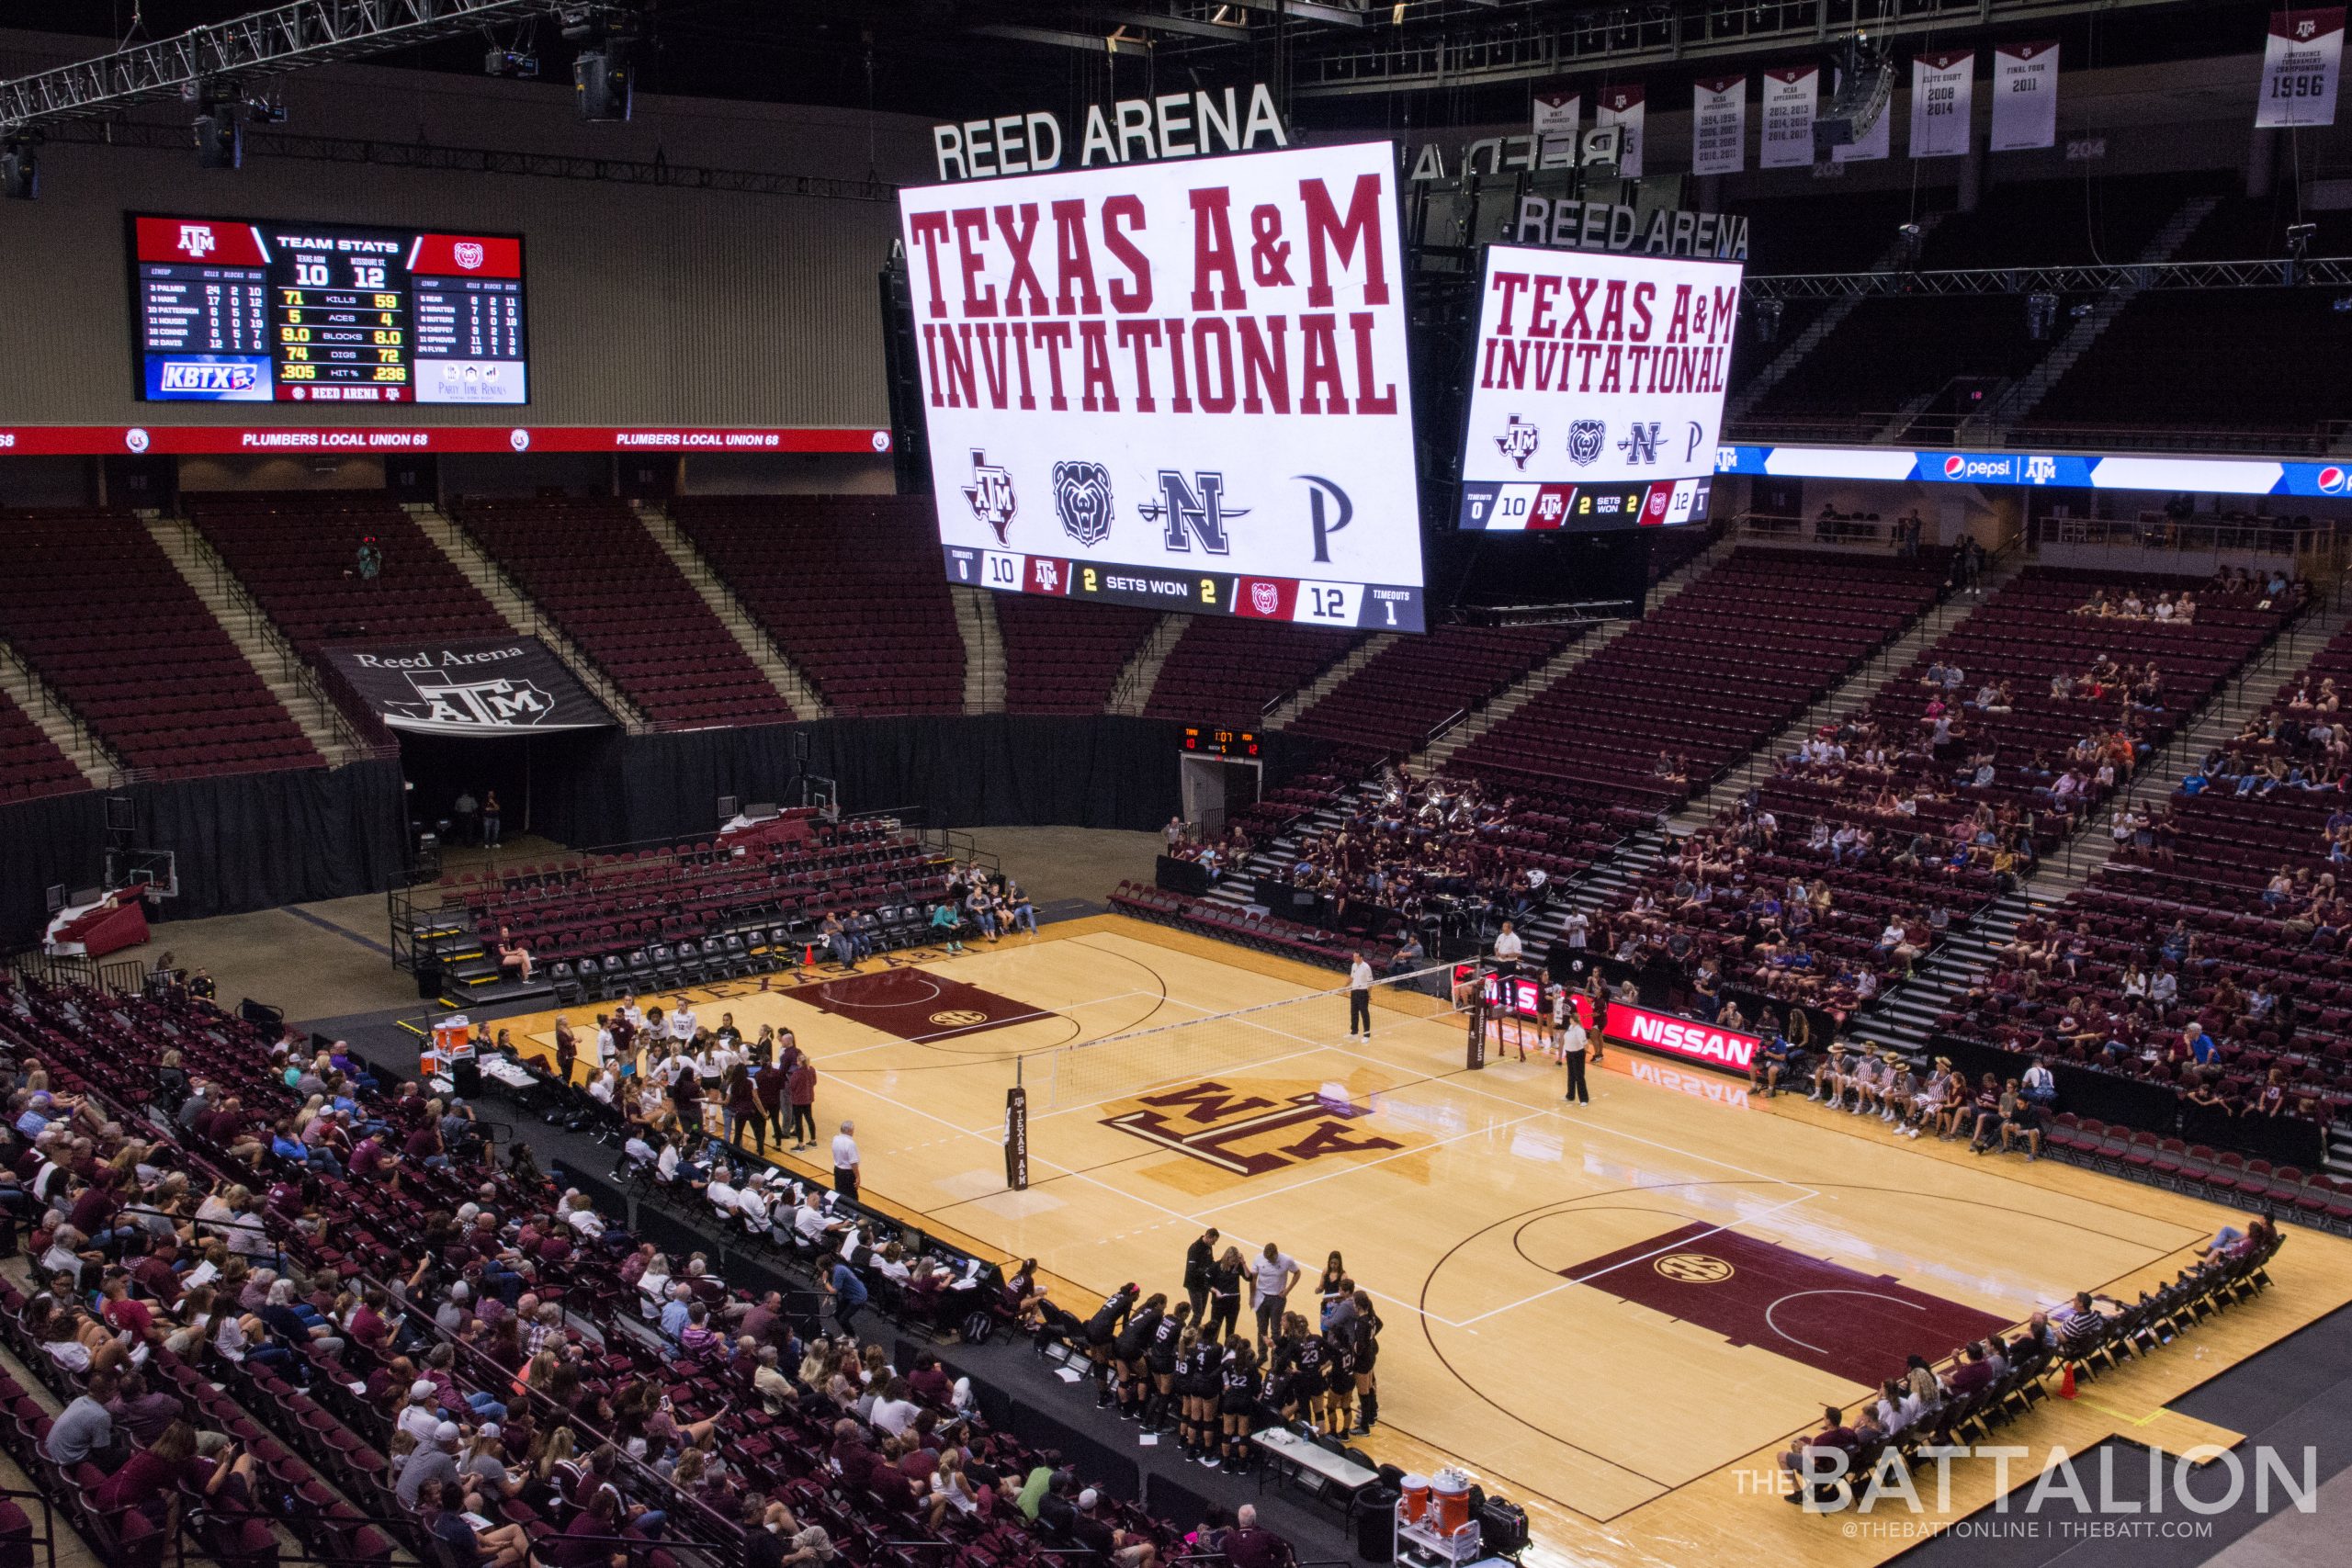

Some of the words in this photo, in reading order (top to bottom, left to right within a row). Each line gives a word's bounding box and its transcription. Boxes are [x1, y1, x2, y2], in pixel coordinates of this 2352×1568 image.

[2012, 78, 2037, 93] 2011
[2271, 74, 2324, 98] 1996
[1927, 102, 1953, 116] 2014
[933, 110, 1062, 181] REED
[1080, 83, 1288, 167] ARENA
[1517, 196, 1636, 250] REED
[1645, 209, 1748, 259] ARENA
[277, 236, 334, 250] TEAM
[337, 239, 399, 254] STATS
[910, 193, 1154, 319] TEXAS
[1188, 173, 1390, 312] A&M
[295, 264, 329, 286] 10
[354, 266, 385, 288] 12
[283, 290, 304, 305] 71
[325, 296, 356, 304] KILLS
[374, 294, 397, 309] 59
[1492, 271, 1655, 344] TEXAS
[1667, 283, 1737, 345] A&M
[288, 309, 301, 323] 5
[328, 314, 356, 322] ACES
[380, 312, 392, 326] 4
[281, 327, 310, 342] 9.0
[322, 333, 363, 341] BLOCKS
[374, 331, 401, 344] 8.0
[286, 346, 309, 361] 74
[331, 351, 356, 359] DIGS
[378, 349, 399, 363] 72
[922, 311, 1398, 415] INVITATIONAL
[280, 365, 315, 379] .305
[373, 367, 406, 381] .236
[1480, 337, 1724, 395] INVITATIONAL
[165, 367, 233, 389] KBTX
[311, 387, 341, 400] REED
[343, 388, 379, 400] ARENA
[438, 382, 459, 395] PARTY
[481, 382, 506, 396] RENTALS
[243, 434, 319, 446] PLUMBERS
[321, 434, 367, 446] LOCAL
[369, 434, 412, 446] UNION
[413, 434, 428, 446] 68
[616, 434, 681, 446] PLUMBERS
[682, 434, 723, 446] LOCAL
[726, 434, 763, 446] UNION
[764, 434, 779, 446] 68
[1967, 460, 2010, 479] pepsi
[1471, 502, 1483, 520] 0
[1501, 497, 1526, 516] 10
[1578, 496, 1591, 514] 2
[1597, 496, 1621, 505] SETS
[1626, 495, 1637, 513] 2
[1674, 491, 1689, 511] 12
[1597, 504, 1619, 513] WON
[958, 559, 968, 580] 0
[990, 557, 1014, 584] 10
[1082, 568, 1097, 592] 2
[1106, 575, 1147, 593] SETS
[1149, 579, 1188, 597] WON
[1201, 579, 1216, 604] 2
[1311, 587, 1345, 619] 12
[1373, 589, 1410, 602] TIMEOUTS
[1385, 601, 1396, 626] 1
[353, 650, 434, 669] Reed
[441, 645, 525, 668] Arena
[658, 963, 865, 1006] TEXAS
[1631, 1015, 1754, 1066] NISSAN
[1016, 1110, 1025, 1156] TEXAS
[1301, 1349, 1319, 1364] 23
